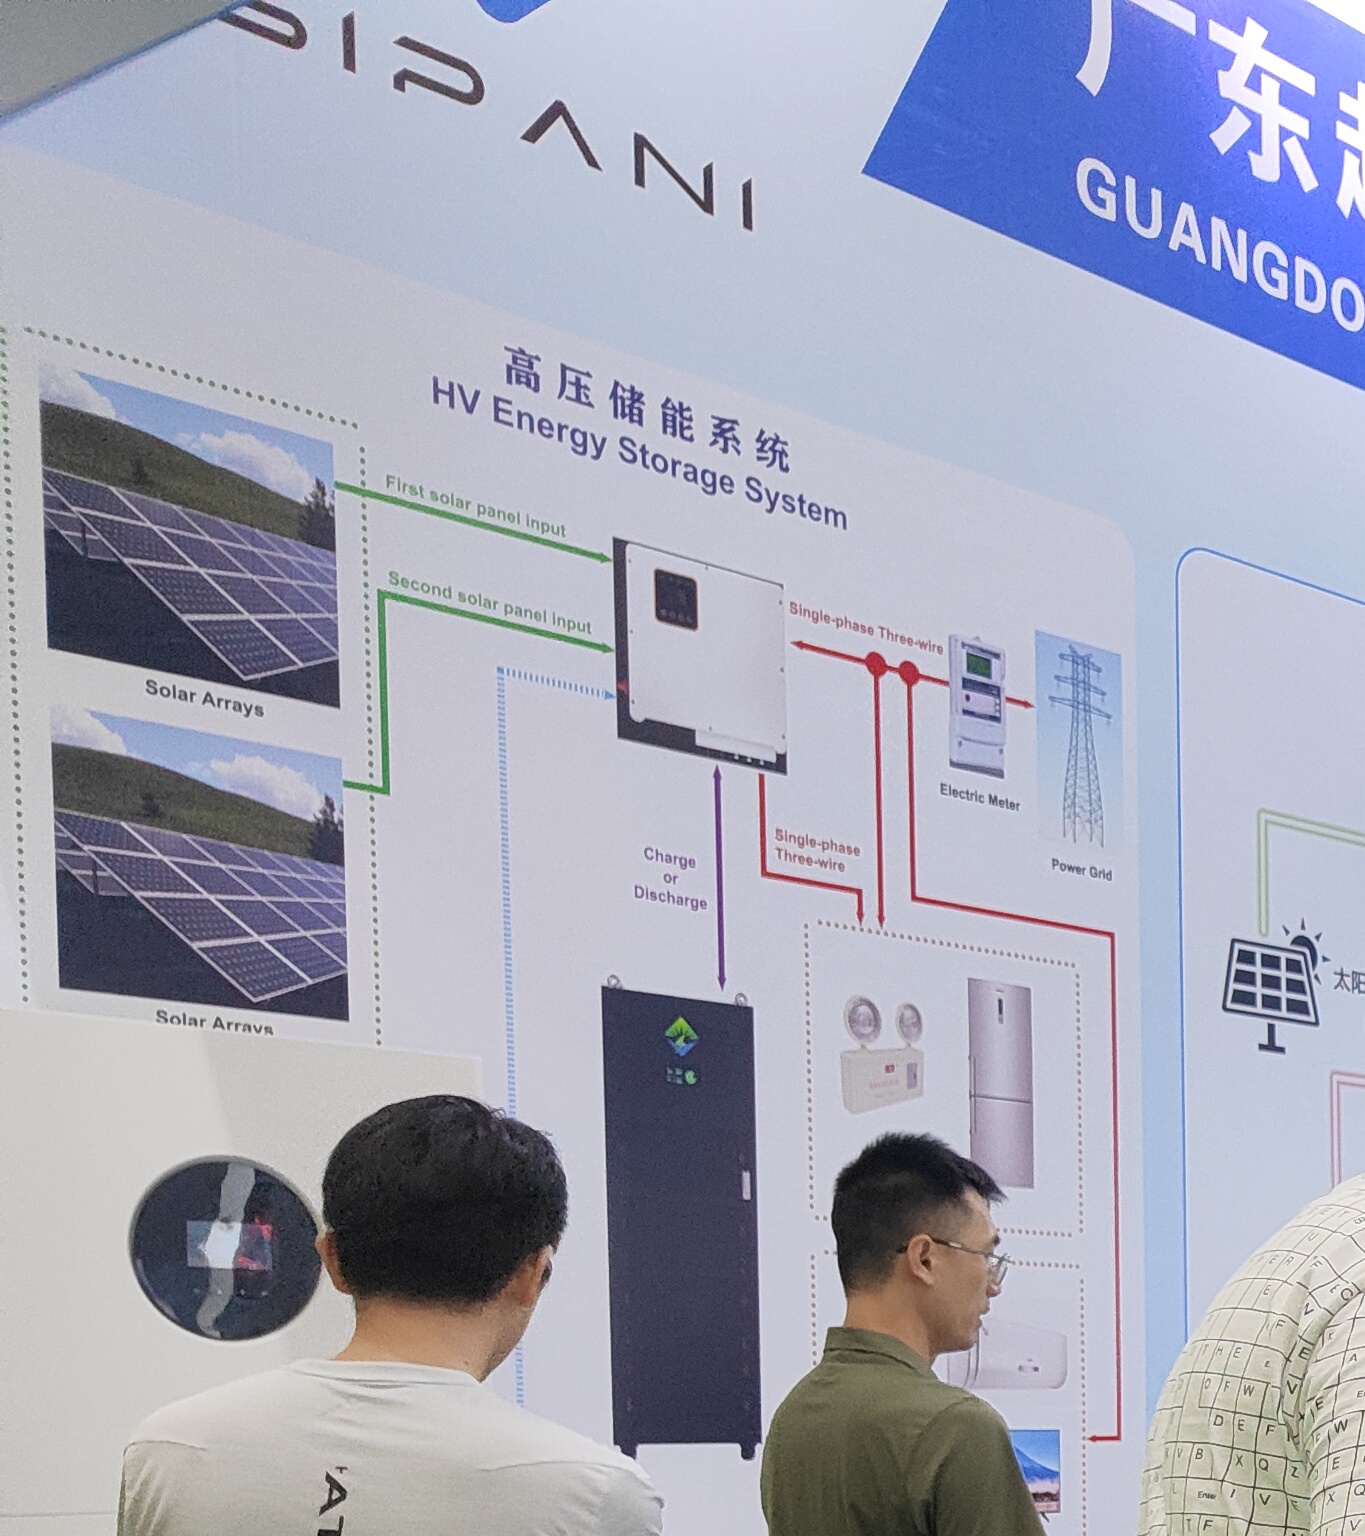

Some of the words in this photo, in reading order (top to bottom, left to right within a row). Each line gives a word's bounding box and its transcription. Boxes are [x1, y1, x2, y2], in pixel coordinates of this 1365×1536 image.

[503, 345, 793, 476] 高压储能系统
[430, 374, 482, 416] HV
[491, 393, 608, 463] Energy
[618, 424, 738, 504] Storage
[743, 469, 850, 532] System
[385, 474, 425, 499] First
[429, 488, 471, 511] solar
[476, 501, 521, 525] panel
[388, 569, 452, 600] Second
[457, 591, 499, 611] solar
[503, 601, 547, 624] panel
[789, 601, 875, 637] Single-phase
[877, 625, 945, 656] Three-wire
[144, 679, 196, 706] Solar
[200, 691, 265, 719] Arrays
[940, 782, 985, 804] Electric
[988, 794, 1021, 812] Meter
[643, 847, 697, 871] Charge
[774, 827, 862, 860] Single-phase
[774, 847, 847, 874] Three-wire
[1051, 857, 1086, 878] Power
[1089, 865, 1113, 884] Grid
[662, 872, 679, 887] or
[633, 885, 708, 912] Discharge
[155, 1008, 207, 1032] Solar
